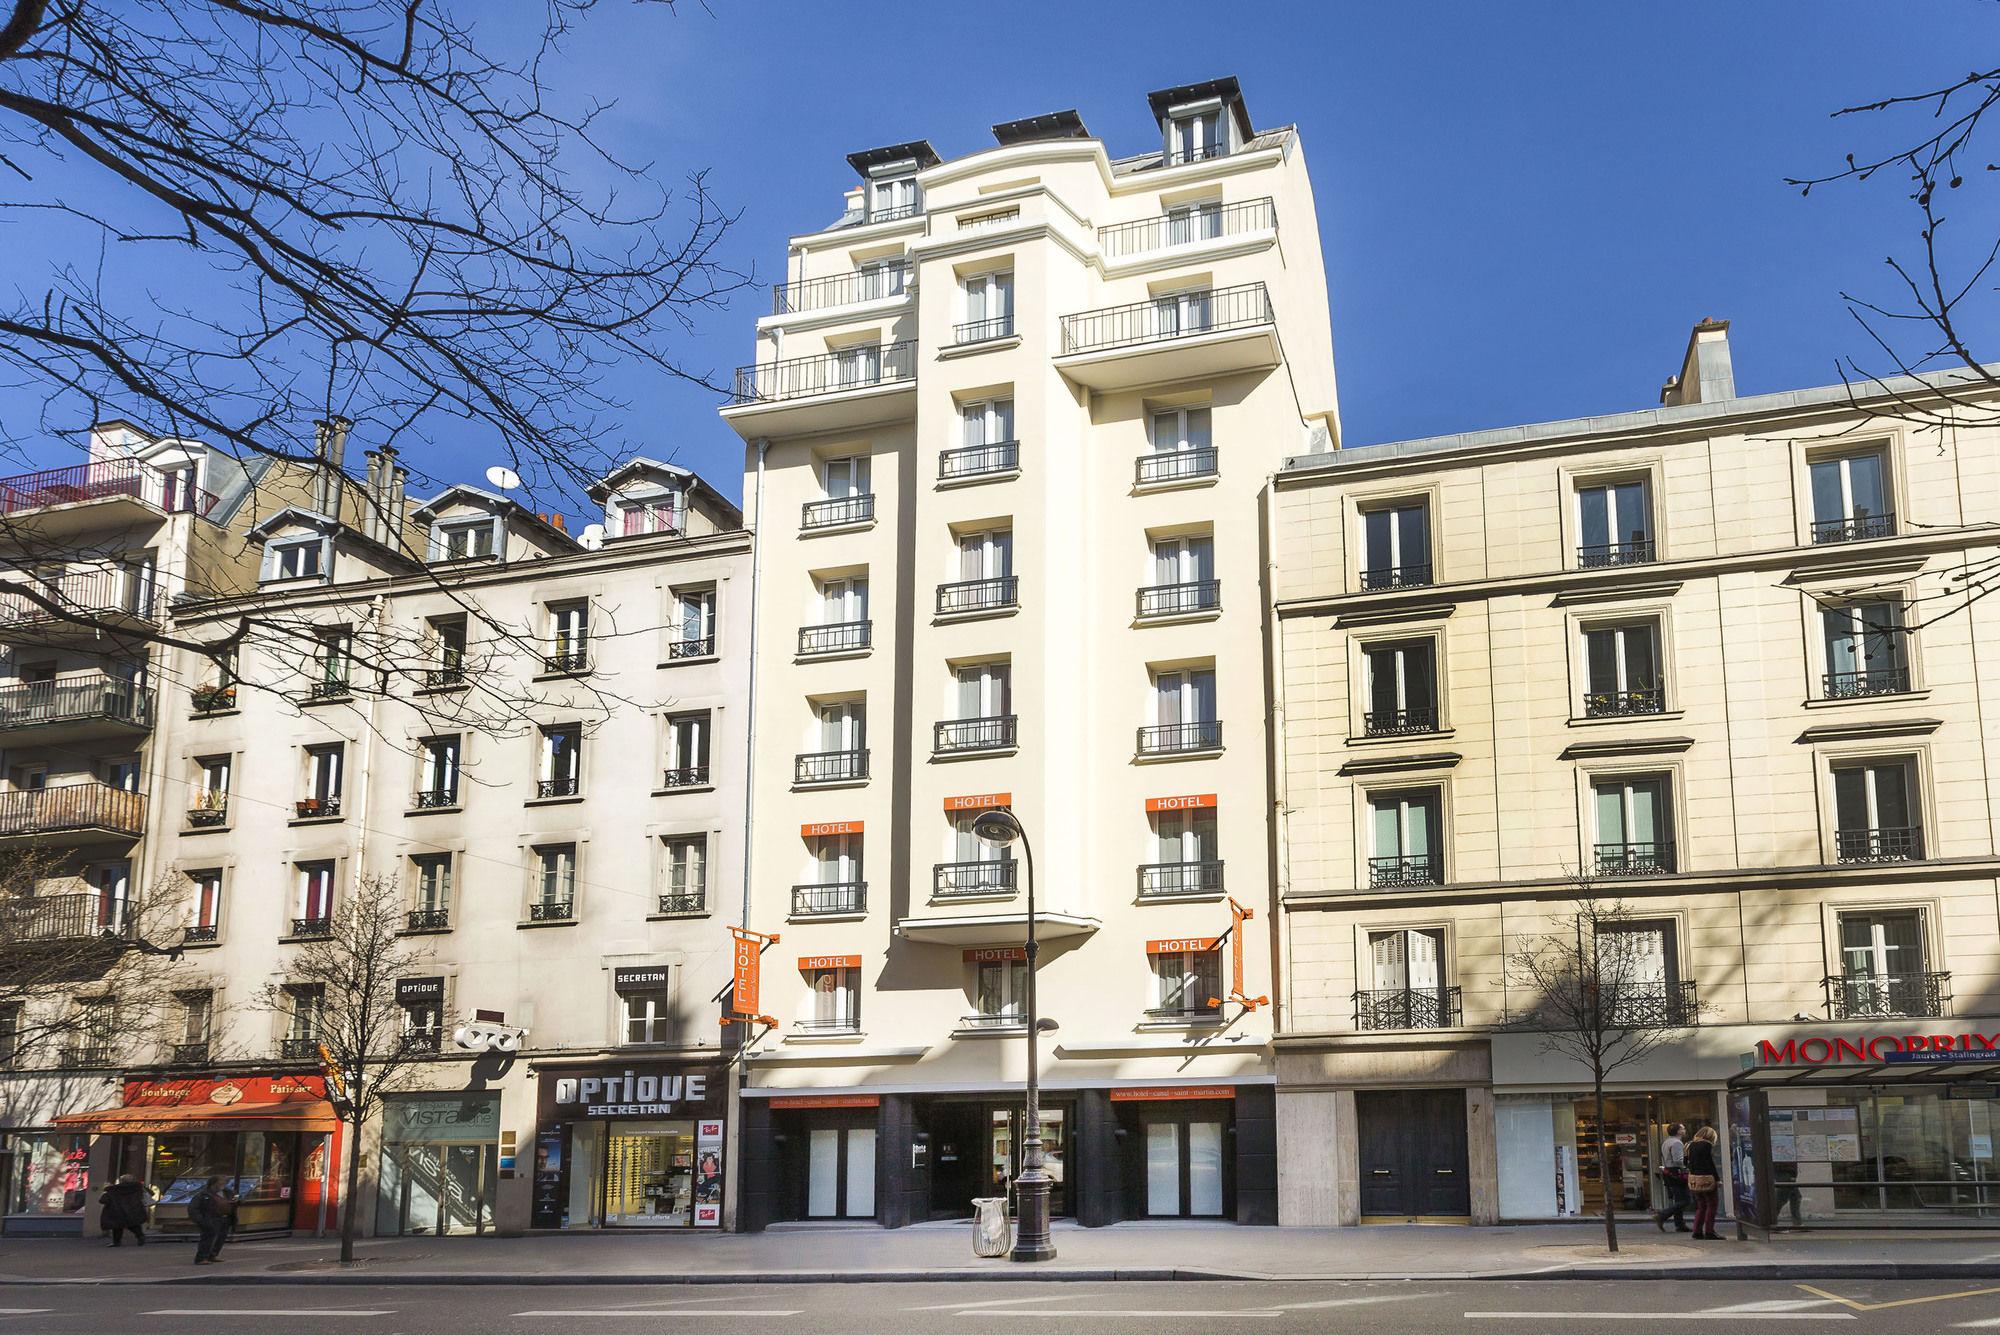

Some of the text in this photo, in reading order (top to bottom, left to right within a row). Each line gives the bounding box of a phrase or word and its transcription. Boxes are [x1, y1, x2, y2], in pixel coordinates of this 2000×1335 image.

[954, 795, 1001, 809] HOTEL
[1157, 797, 1205, 809] HOTEL
[811, 823, 853, 835] HOTEL
[1159, 940, 1207, 952] HOTEL
[975, 949, 1019, 960] HOTEL
[809, 957, 850, 968] HOTEL
[617, 973, 665, 983] SECRETAN
[738, 943, 749, 1002] HOTEL
[1762, 1033, 2000, 1064] MONOPRIX
[1949, 1051, 1997, 1059] Stalingrad
[141, 1087, 191, 1098] Boulanger
[587, 1104, 671, 1116] SECRETAN
[1471, 1104, 1480, 1114] 7
